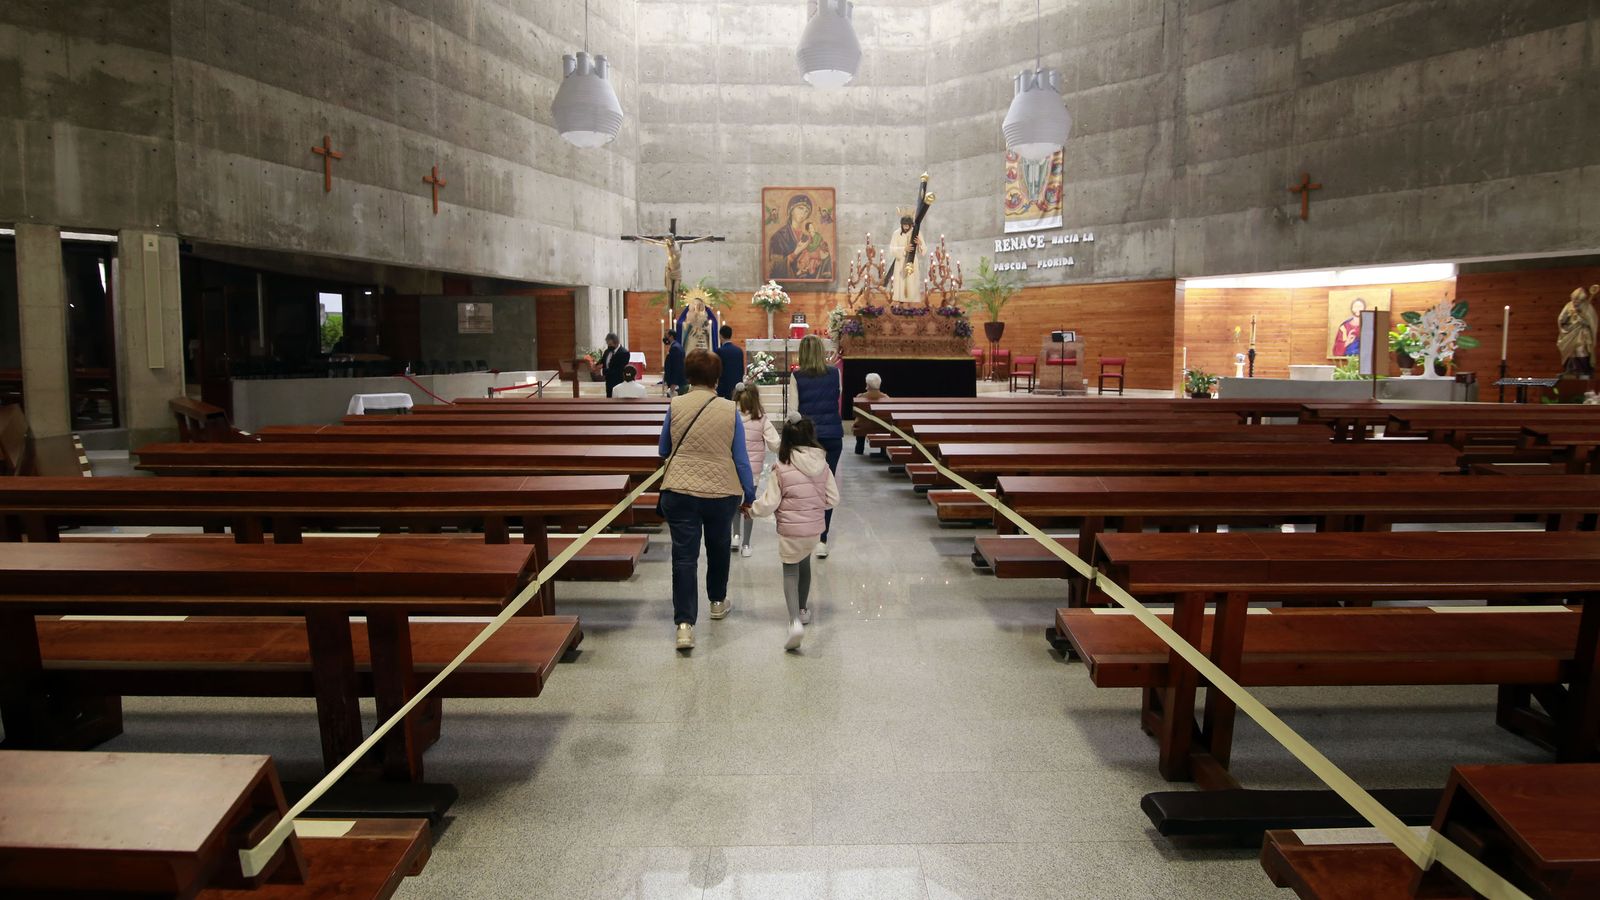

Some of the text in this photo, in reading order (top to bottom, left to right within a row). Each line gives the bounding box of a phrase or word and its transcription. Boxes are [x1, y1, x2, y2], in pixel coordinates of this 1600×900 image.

[994, 233, 1094, 252] RENACE HACIA LA
[994, 257, 1074, 271] PASCUA FLORIDA
